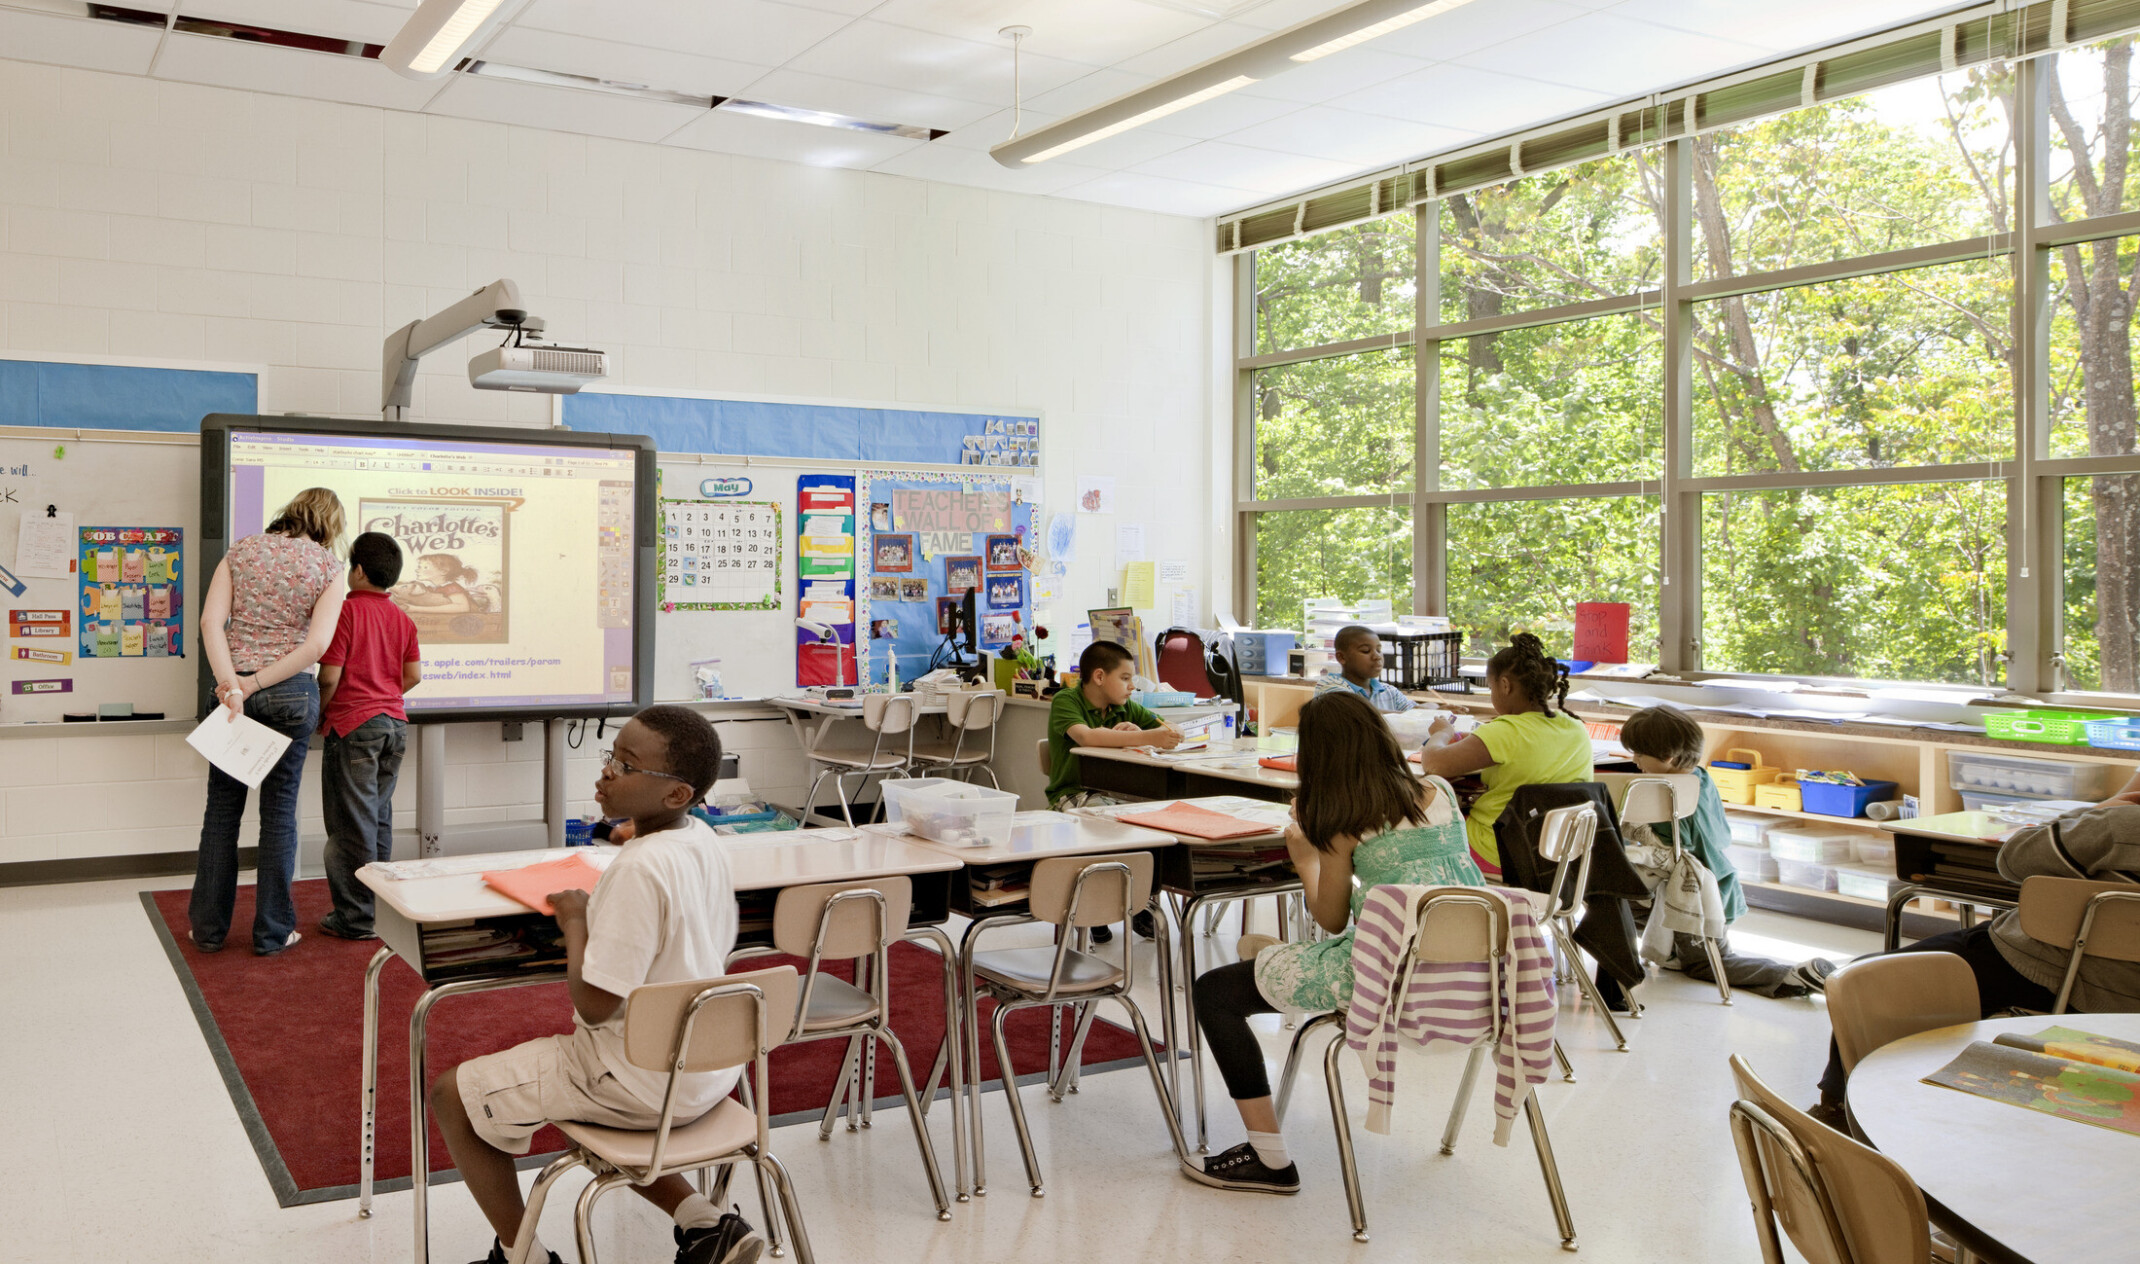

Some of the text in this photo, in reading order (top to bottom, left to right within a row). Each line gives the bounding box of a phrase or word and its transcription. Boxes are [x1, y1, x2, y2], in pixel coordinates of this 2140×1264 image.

[430, 487, 470, 496] LOOK
[474, 488, 523, 496] INSIDE!
[714, 483, 739, 492] May
[364, 512, 500, 538] Charlotte's
[903, 511, 992, 532] WALL OF
[687, 527, 692, 535] 9
[764, 529, 772, 538] 14
[400, 532, 466, 554] Web
[920, 532, 972, 552] FAME
[733, 545, 742, 553] 19
[748, 544, 758, 552] 20
[718, 560, 727, 568] 25
[732, 560, 741, 568] 26
[748, 560, 757, 568] 27
[764, 560, 773, 568] 28
[701, 576, 710, 584] 31
[1585, 624, 1608, 638] and
[32, 652, 58, 660] Bathroom
